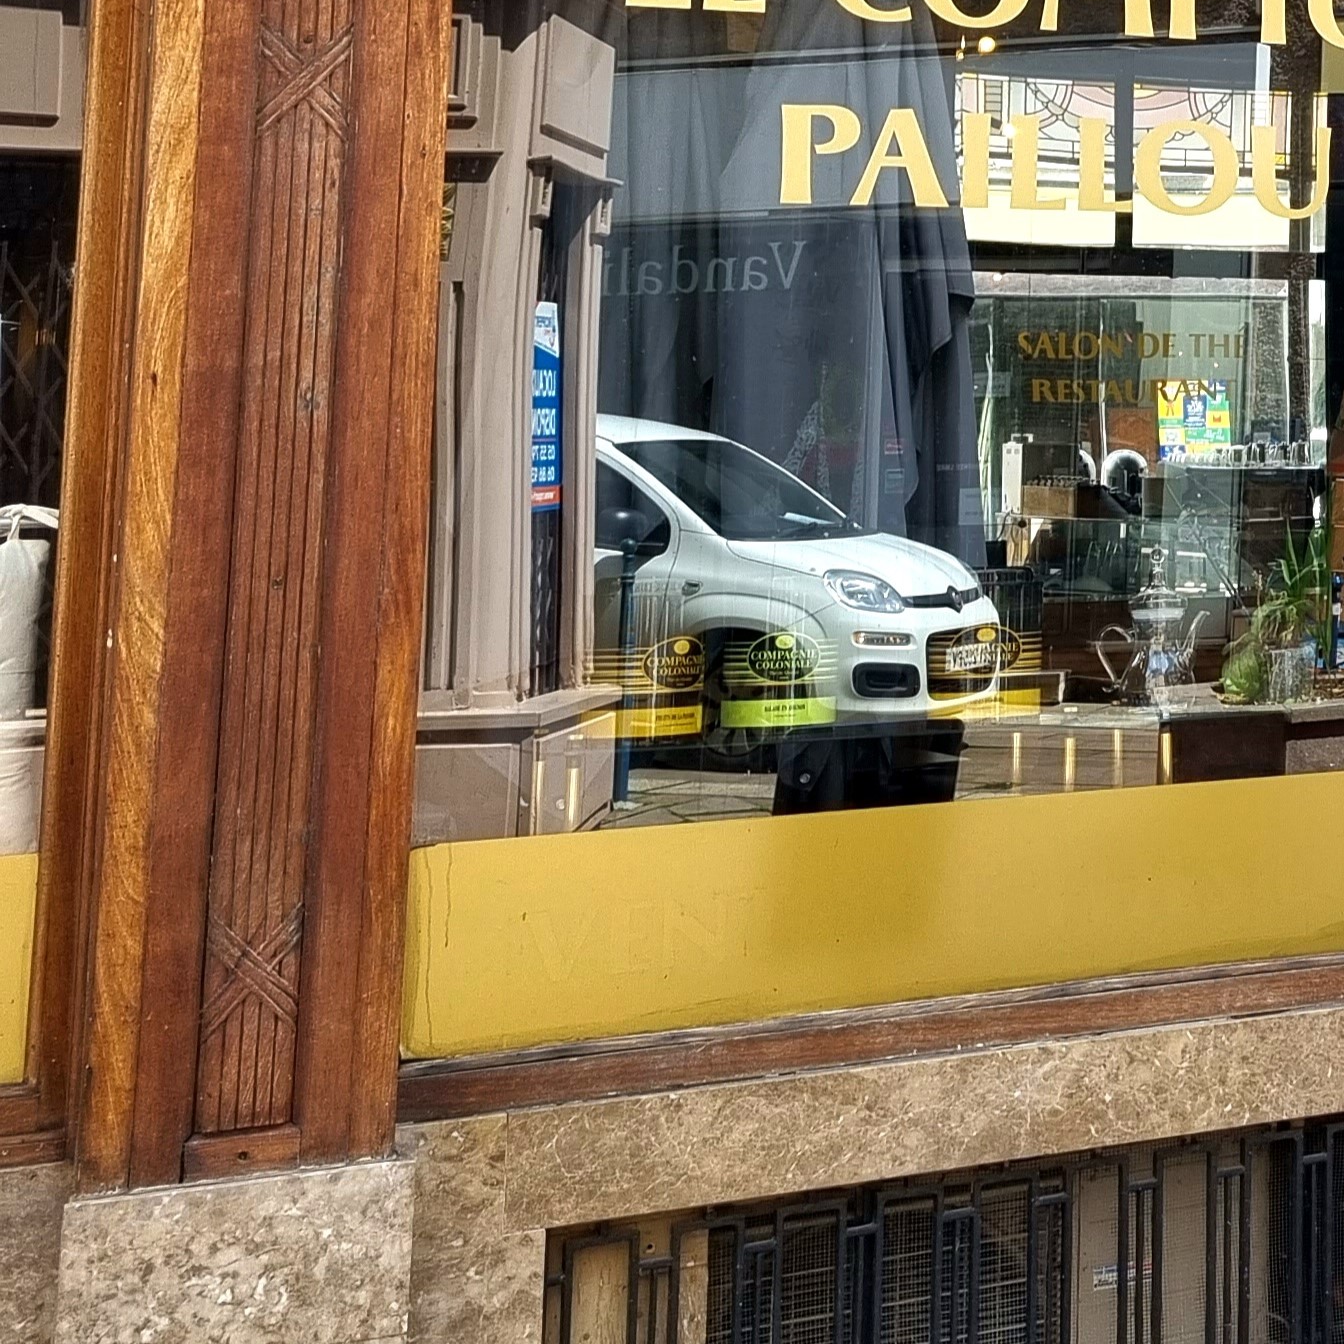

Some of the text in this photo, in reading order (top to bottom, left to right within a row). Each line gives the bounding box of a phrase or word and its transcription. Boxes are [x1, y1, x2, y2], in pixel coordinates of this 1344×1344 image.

[1017, 331, 1124, 361] SALON
[1137, 332, 1177, 359] DE
[1031, 377, 1237, 404] RESTAURANT
[750, 649, 817, 661] COMPAGNIE
[755, 659, 812, 670] COLONIALE
